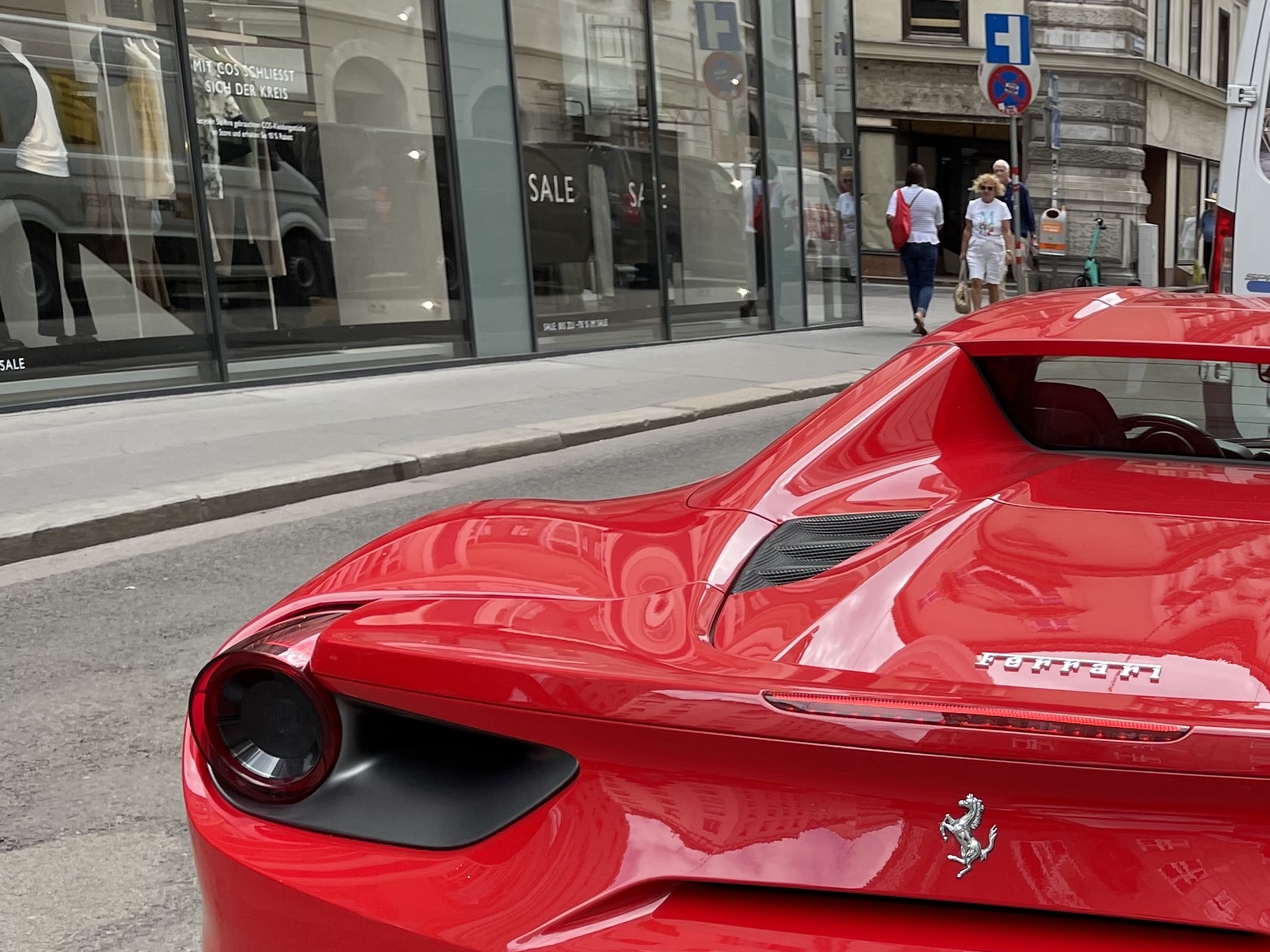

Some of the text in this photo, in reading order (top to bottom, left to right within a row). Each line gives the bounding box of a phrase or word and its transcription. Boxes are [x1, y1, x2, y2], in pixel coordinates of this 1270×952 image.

[193, 60, 294, 82] MIT COS SCHLIESST
[205, 80, 288, 100] SICH DER KREIS
[528, 173, 575, 203] SALE
[0, 358, 26, 371] SALE
[975, 652, 1162, 683] Ferrari
